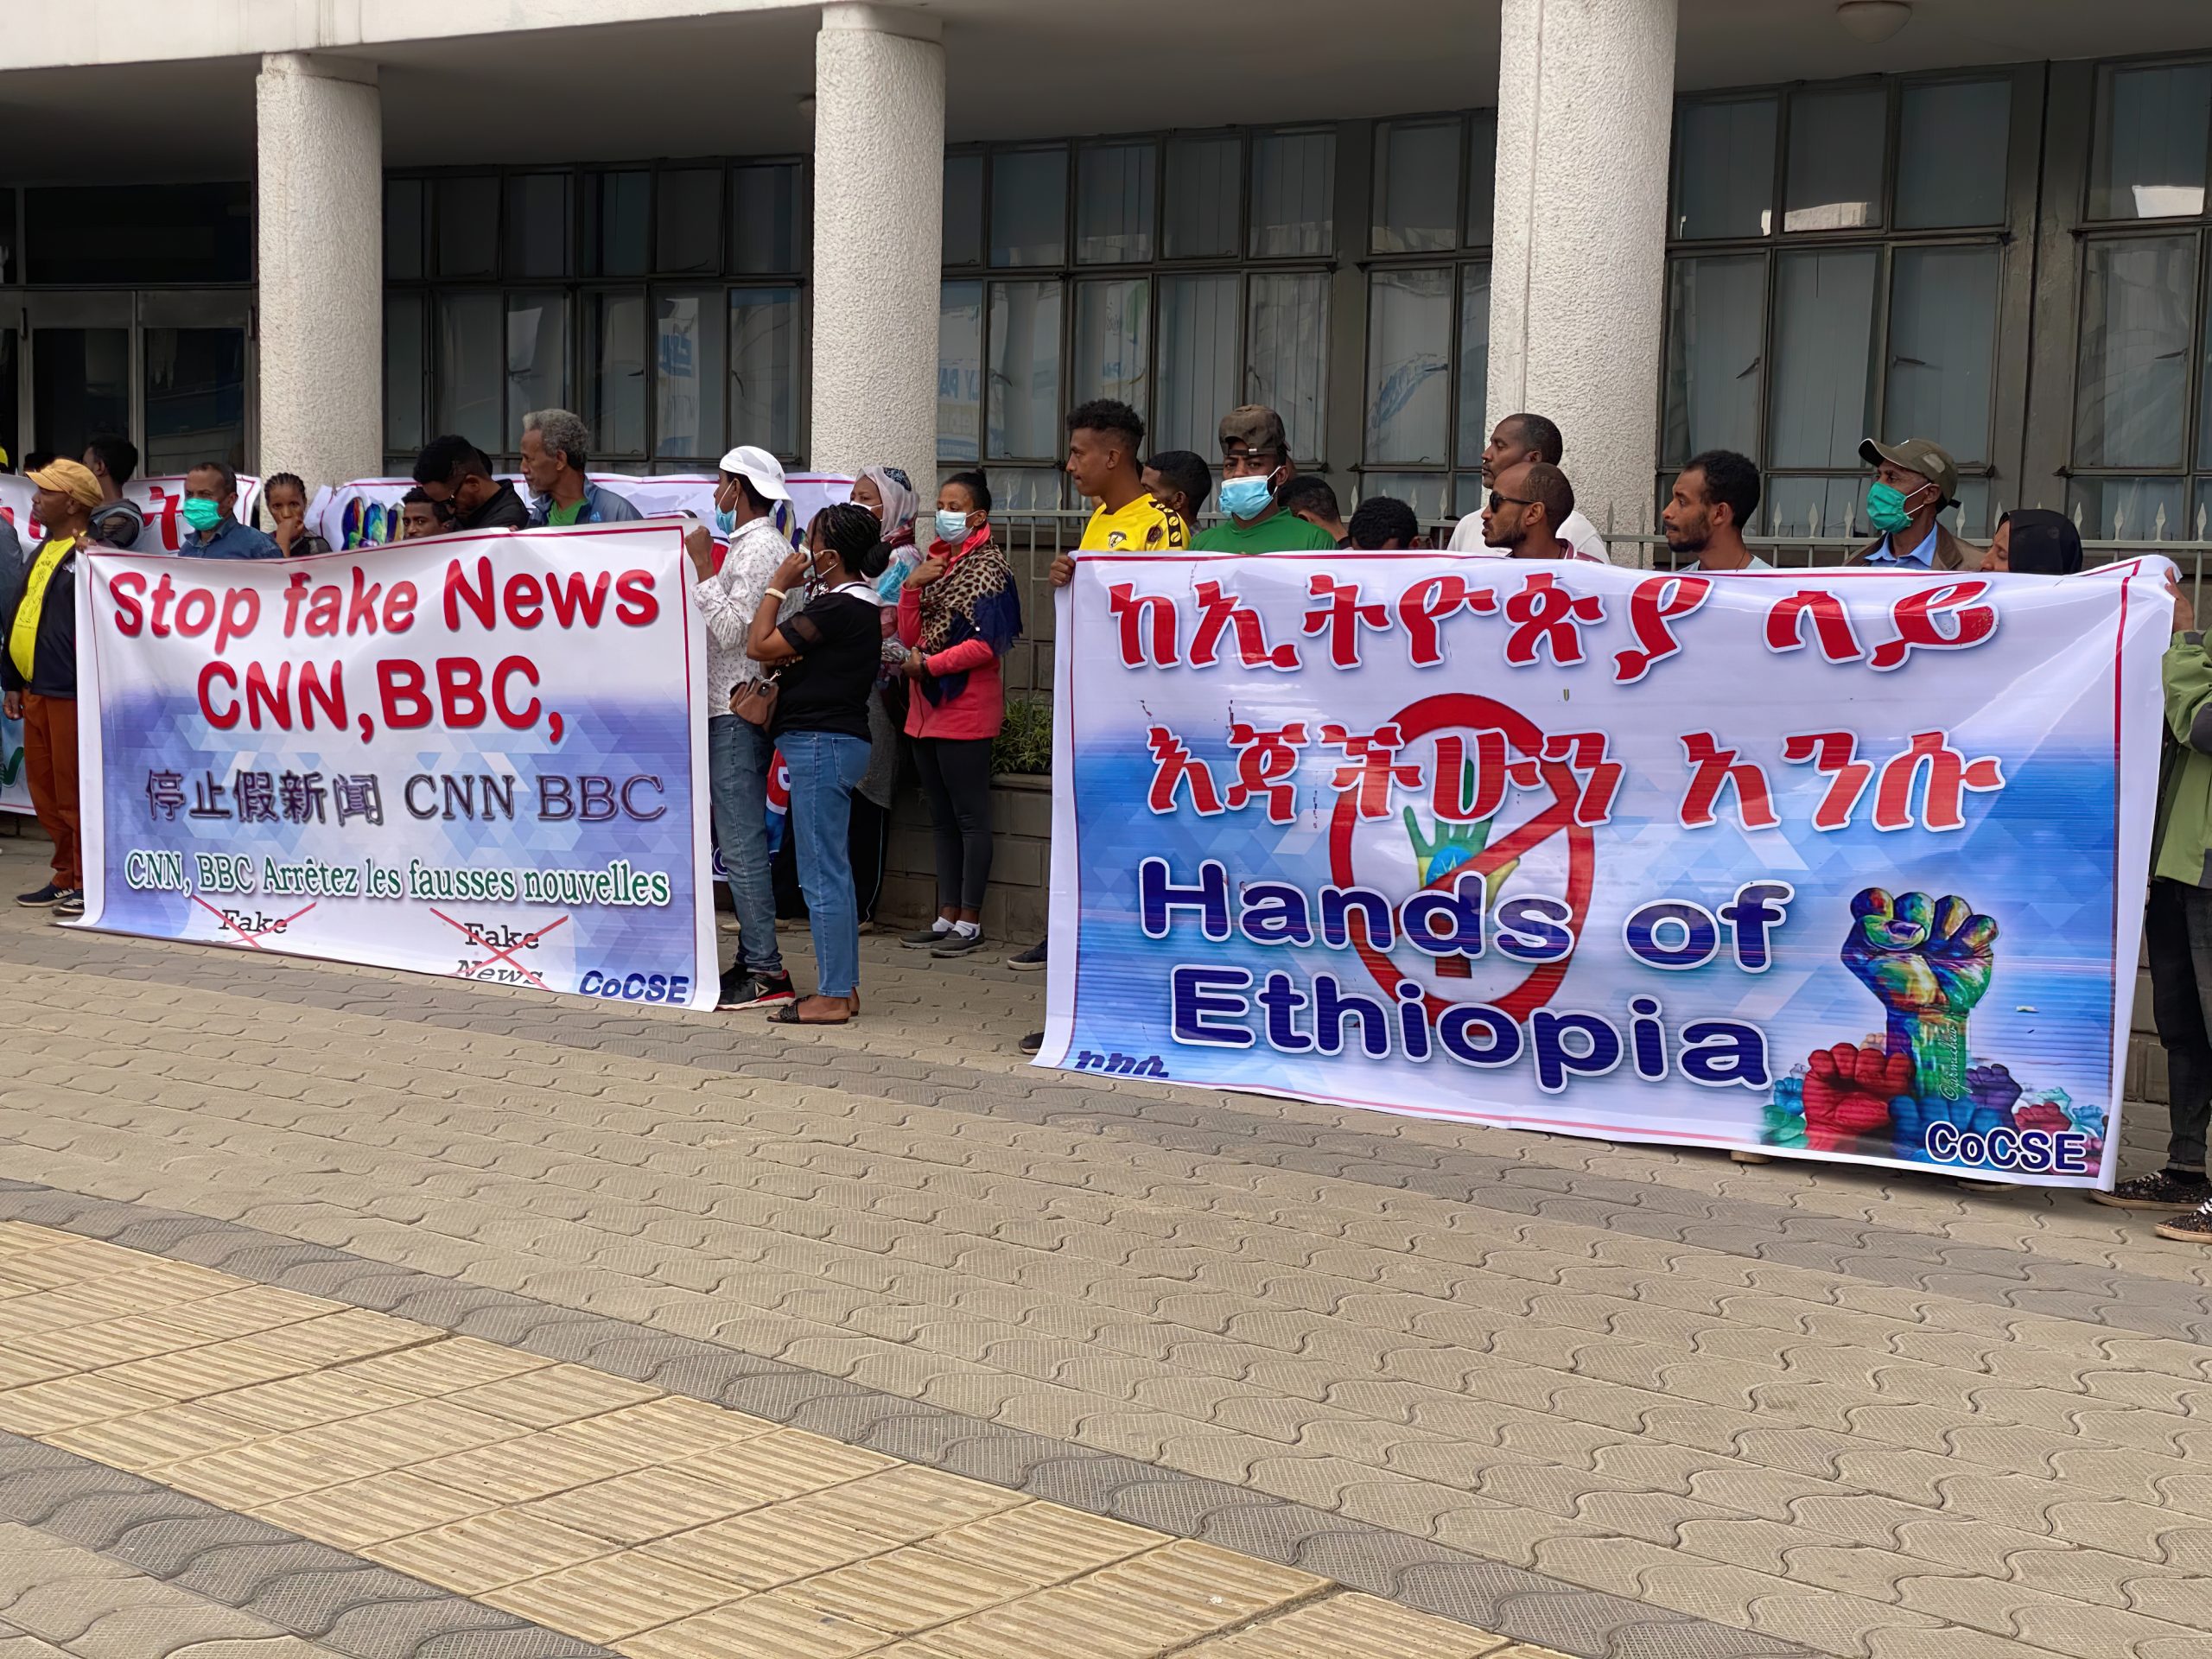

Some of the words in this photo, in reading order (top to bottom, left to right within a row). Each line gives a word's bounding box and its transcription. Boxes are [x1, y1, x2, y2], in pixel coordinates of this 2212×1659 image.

[110, 571, 260, 654] Stop
[283, 565, 418, 638] fake
[443, 556, 660, 631] News
[145, 767, 384, 827] 停止假新闻
[404, 773, 516, 820] CNN
[535, 773, 668, 821] BBC
[1677, 728, 2005, 832] አንሱ
[125, 850, 193, 897] CNN,
[194, 853, 254, 893] BBC
[262, 855, 360, 896] Arrêtez
[365, 856, 403, 896] les
[409, 858, 517, 900] fausses
[522, 861, 671, 905] nouvelles
[218, 908, 288, 934] Fake
[463, 922, 540, 950] Fake
[1139, 856, 1575, 964] Hands
[1622, 880, 1796, 974] of
[578, 969, 690, 1005] CoCSE
[1170, 963, 1774, 1095] Ethiopia
[1925, 1120, 2088, 1175] CoCSE
